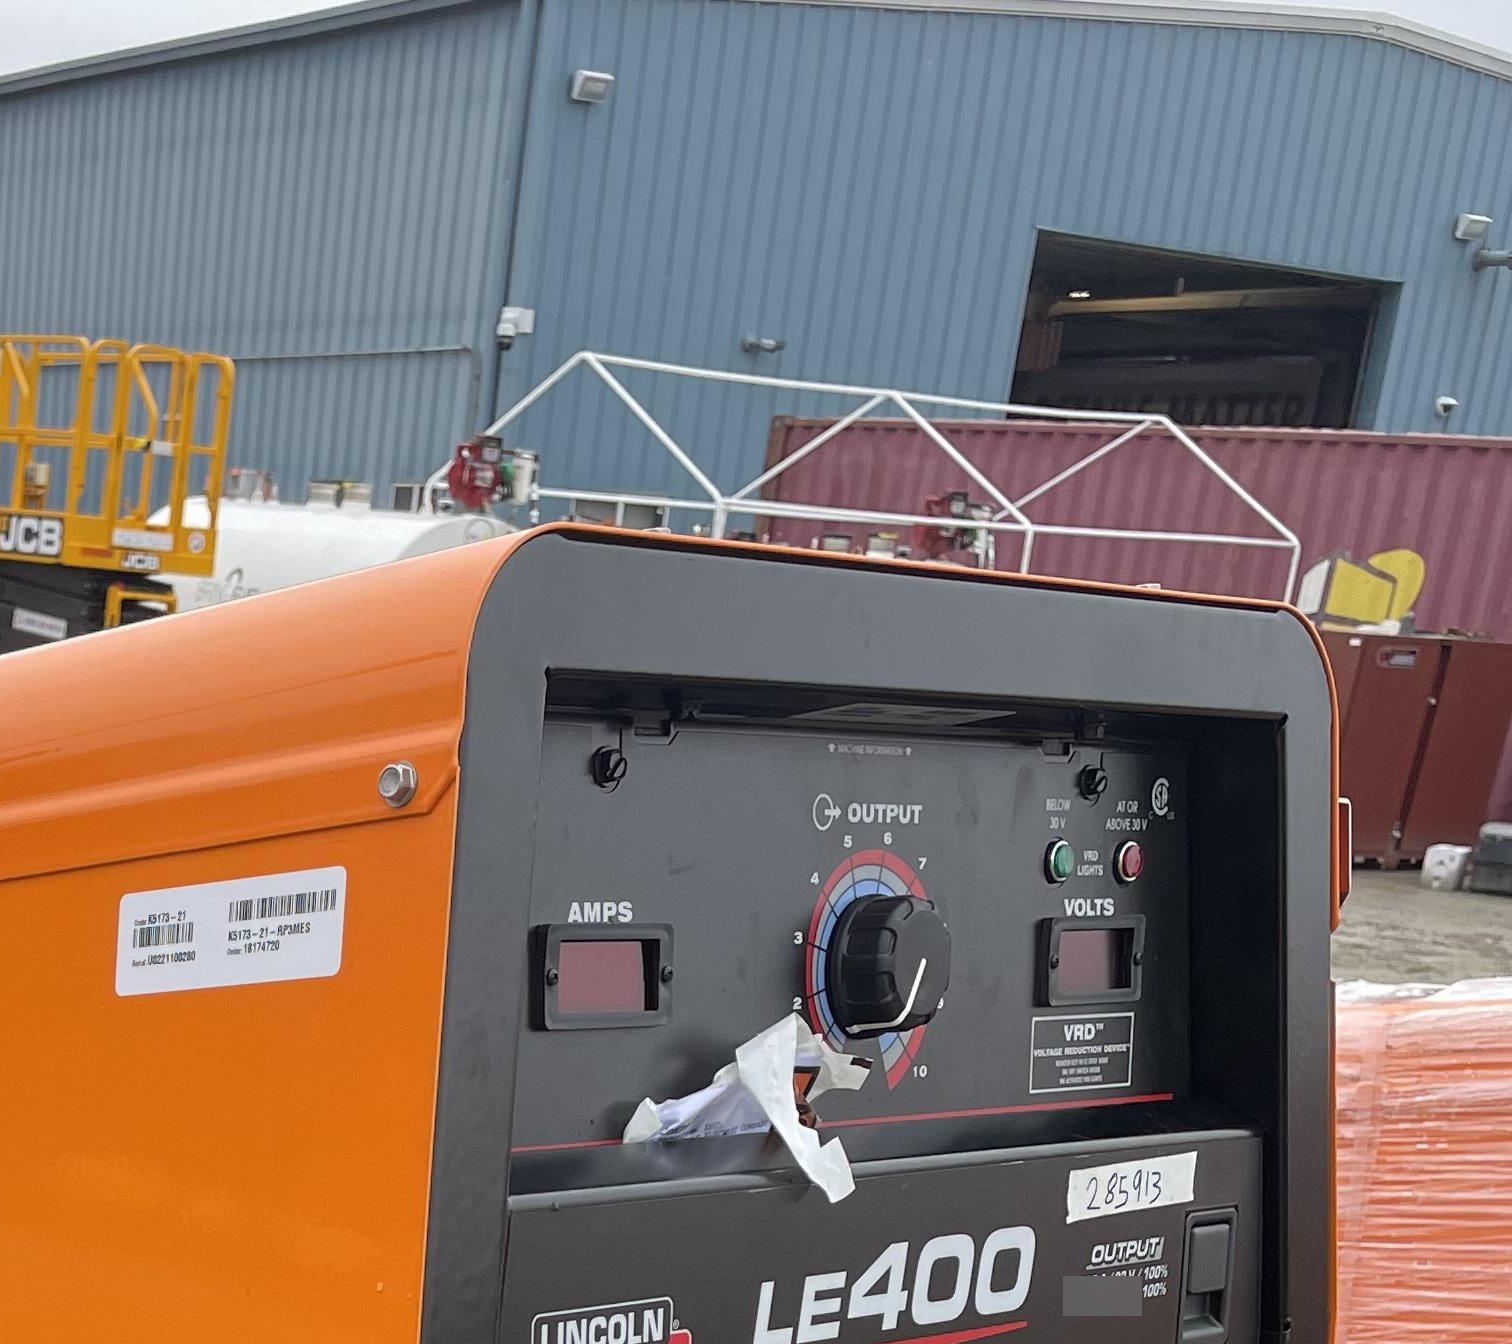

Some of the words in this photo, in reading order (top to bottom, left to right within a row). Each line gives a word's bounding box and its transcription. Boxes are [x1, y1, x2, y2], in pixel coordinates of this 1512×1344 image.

[1046, 799, 1071, 811] BELOW
[848, 803, 923, 824] OUTPUT
[1050, 817, 1059, 829] 30
[1105, 818, 1131, 830] ABOVE
[844, 836, 852, 847] 5
[884, 832, 892, 844] 6
[918, 858, 927, 869] 7
[1077, 865, 1104, 876] LIGHTS
[811, 872, 820, 885] 4
[566, 902, 633, 924] AMPS
[1064, 898, 1115, 916] VOLTS
[794, 932, 803, 944] 3
[792, 997, 802, 1010] 2
[913, 1065, 927, 1077] 10
[1086, 1169, 1162, 1210] 285913
[1091, 1238, 1160, 1265] OUTPUT
[1144, 1265, 1168, 1281] 100%
[1142, 1283, 1167, 1298] 100%
